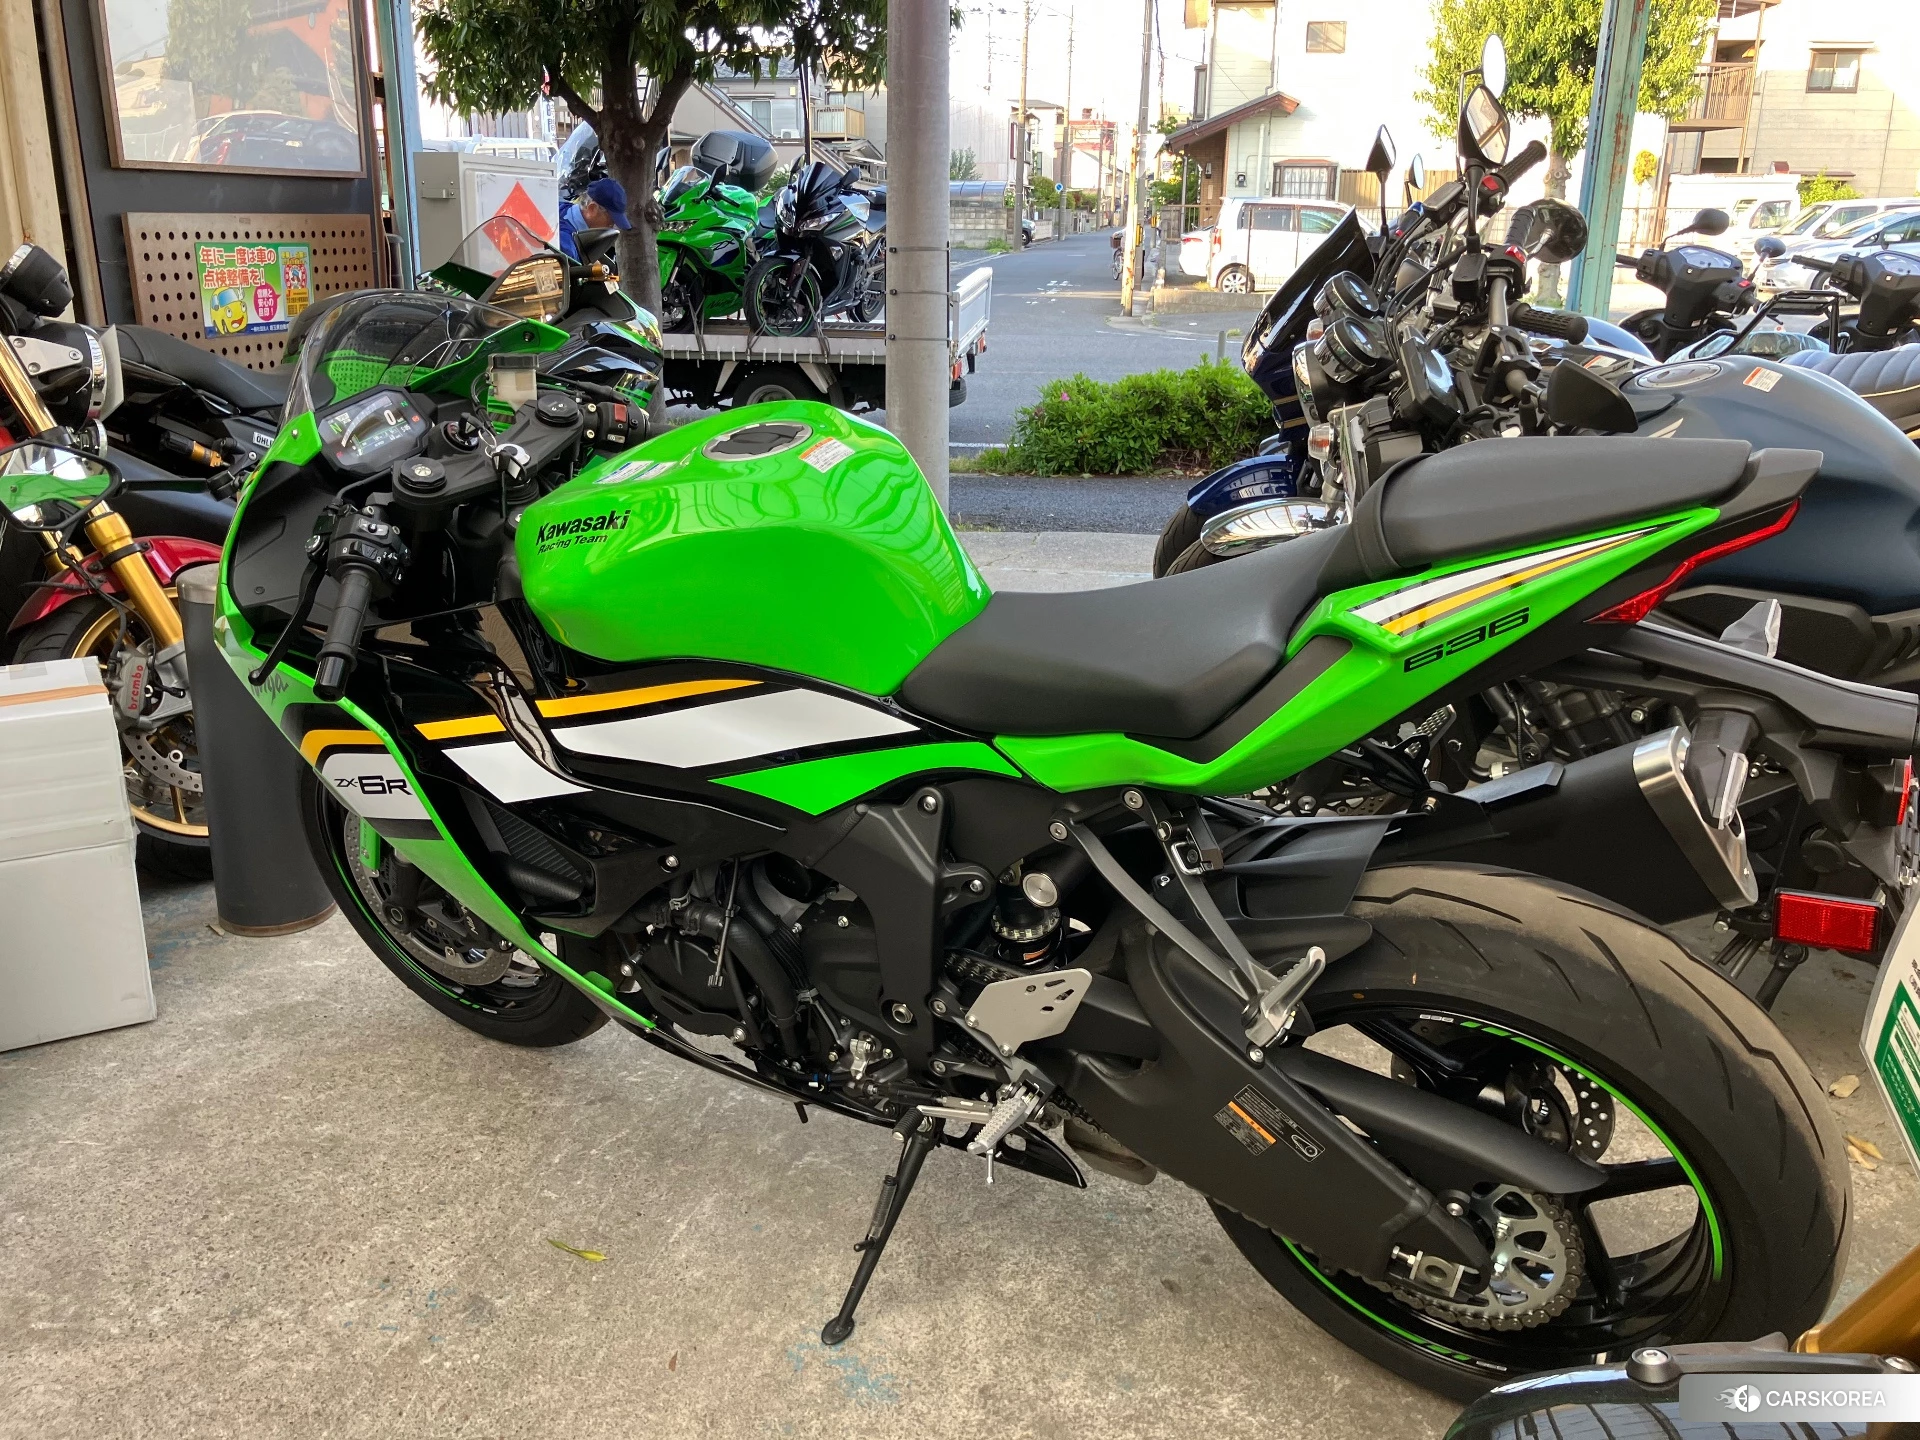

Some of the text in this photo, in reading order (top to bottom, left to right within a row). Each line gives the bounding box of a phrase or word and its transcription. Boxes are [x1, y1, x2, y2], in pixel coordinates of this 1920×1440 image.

[200, 246, 276, 266] 年に一度は車の
[383, 409, 397, 426] 0
[536, 509, 631, 546] Kawasaki
[537, 534, 609, 555] Racing Team
[1403, 606, 1530, 674] 636
[128, 664, 144, 710] brembo
[334, 775, 413, 795] ZX-6R
